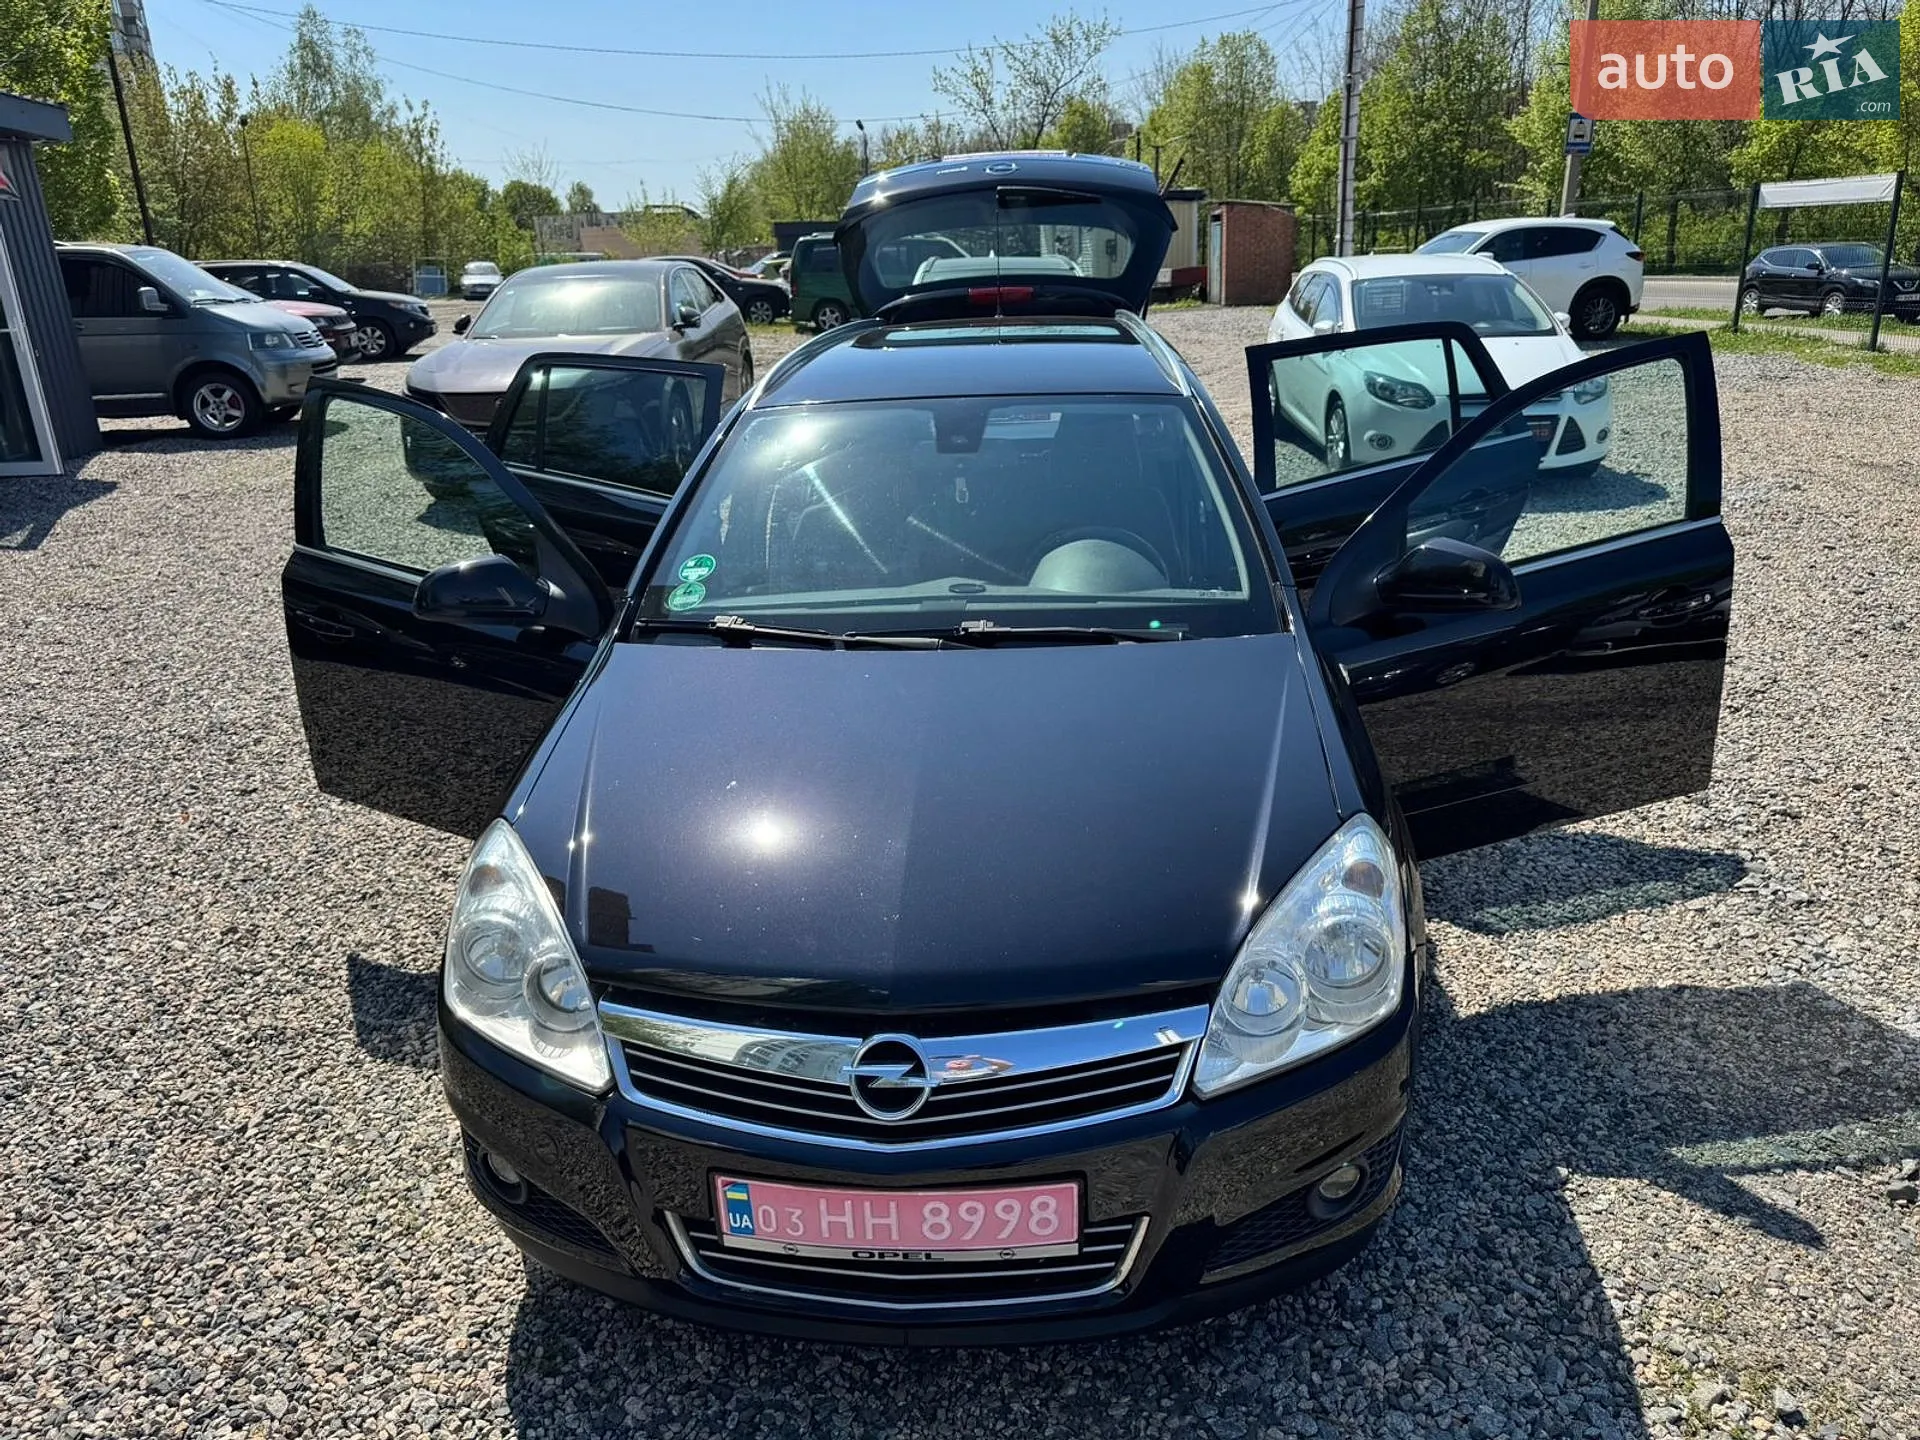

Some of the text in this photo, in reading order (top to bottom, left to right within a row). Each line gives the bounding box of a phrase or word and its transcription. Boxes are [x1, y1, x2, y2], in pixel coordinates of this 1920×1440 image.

[729, 1212, 753, 1230] UA
[758, 1195, 1059, 1241] 03 HH 8998
[851, 1249, 945, 1262] OPEL
